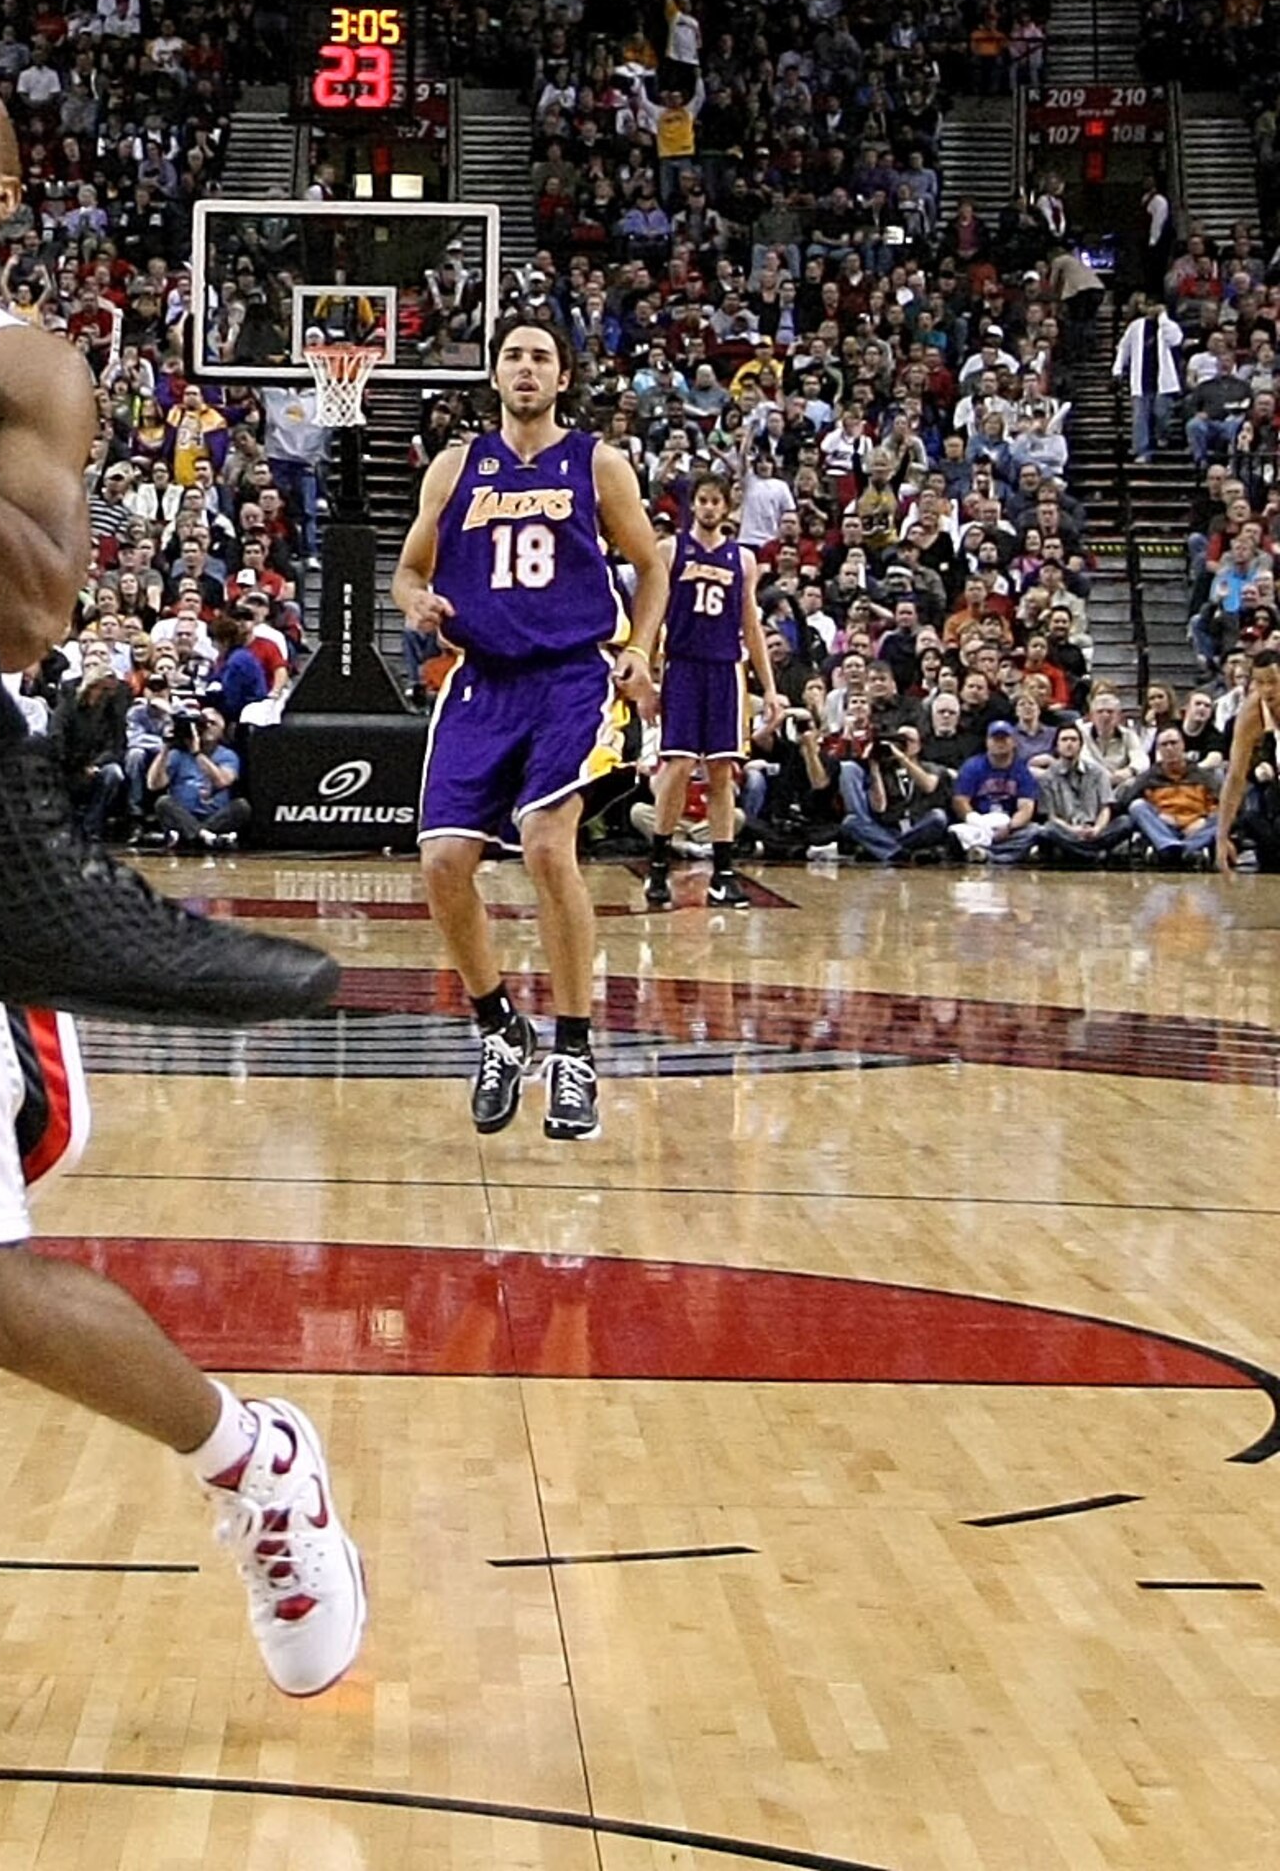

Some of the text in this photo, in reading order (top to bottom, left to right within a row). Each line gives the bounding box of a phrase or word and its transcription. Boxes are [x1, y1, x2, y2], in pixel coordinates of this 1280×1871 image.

[331, 8, 400, 44] 3:05
[313, 45, 391, 107] 23
[1045, 88, 1146, 108] 209 210
[1047, 126, 1081, 144] 107
[490, 523, 555, 589] 18
[693, 582, 725, 616] 16
[274, 804, 416, 824] NAUTILUS
